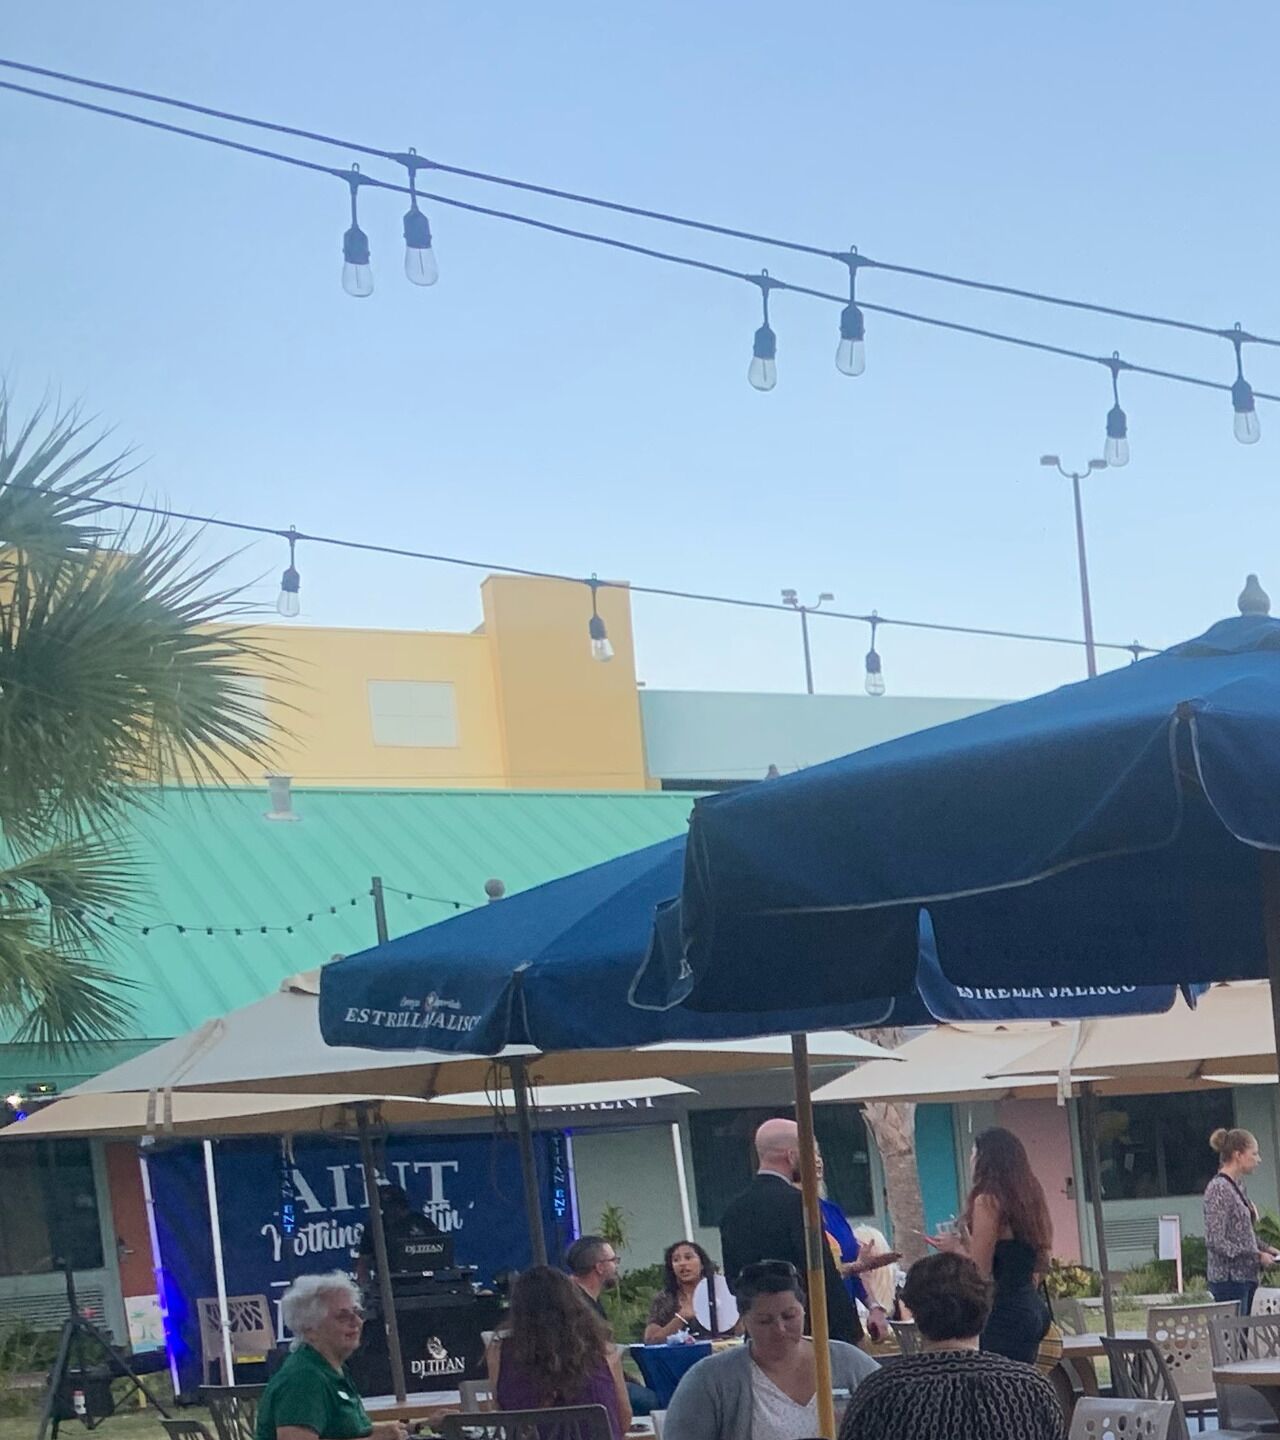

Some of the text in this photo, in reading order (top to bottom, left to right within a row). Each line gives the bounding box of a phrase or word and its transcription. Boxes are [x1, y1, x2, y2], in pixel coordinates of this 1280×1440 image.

[554, 1188, 567, 1217] ENT
[283, 1204, 295, 1234] ENT
[411, 1356, 465, 1379] DJ TITAN
